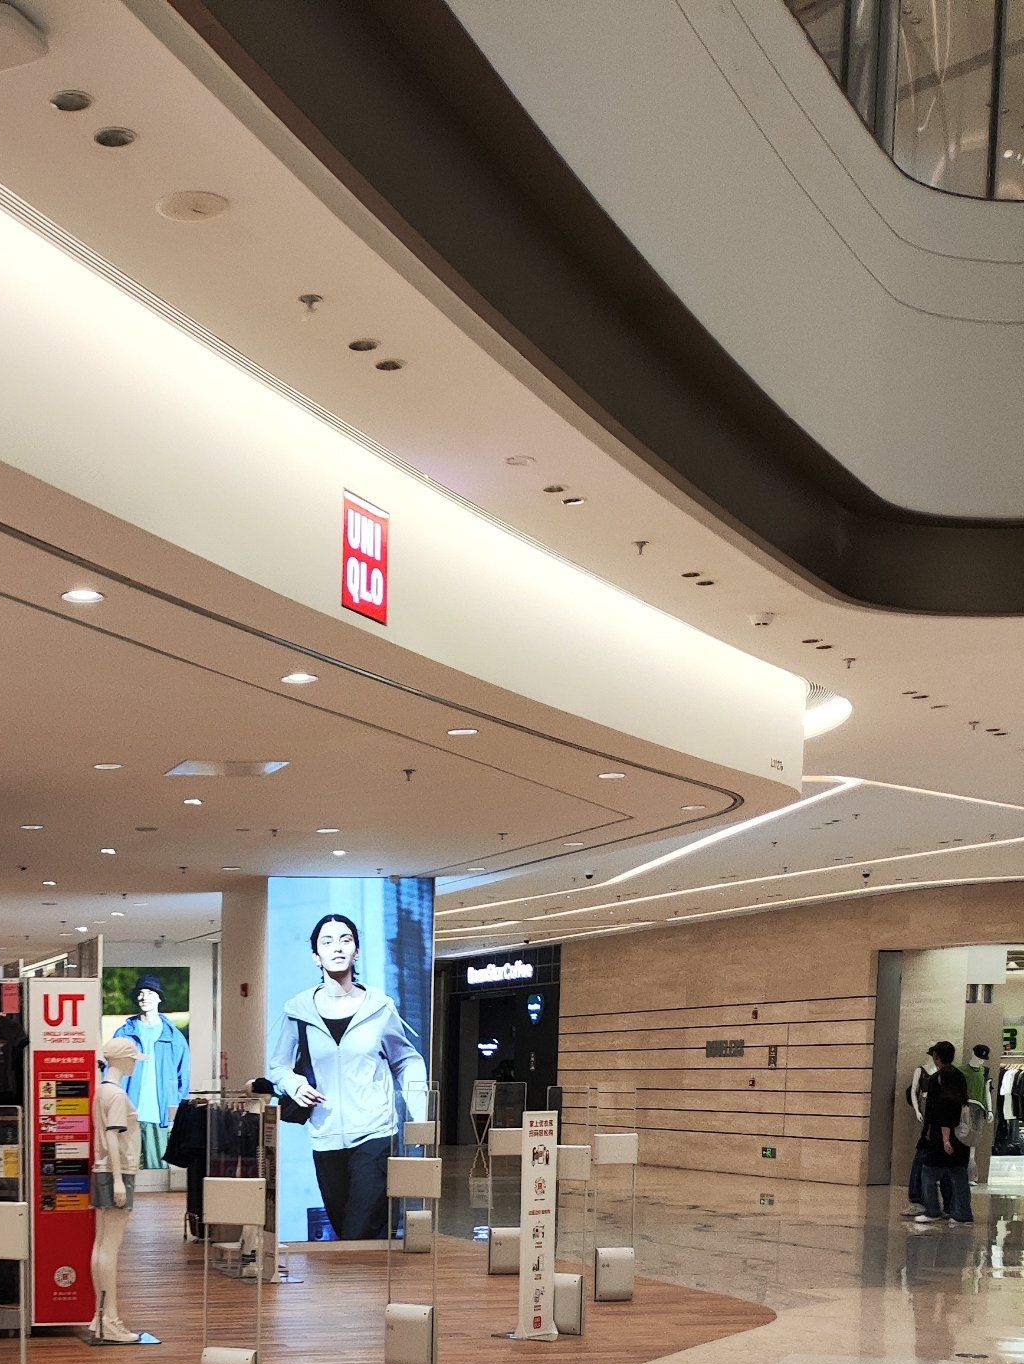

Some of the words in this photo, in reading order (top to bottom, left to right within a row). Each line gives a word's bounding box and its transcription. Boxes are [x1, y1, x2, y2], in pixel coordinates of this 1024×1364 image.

[347, 508, 382, 561] UNI
[346, 556, 384, 606] QLO
[43, 993, 85, 1027] UT
